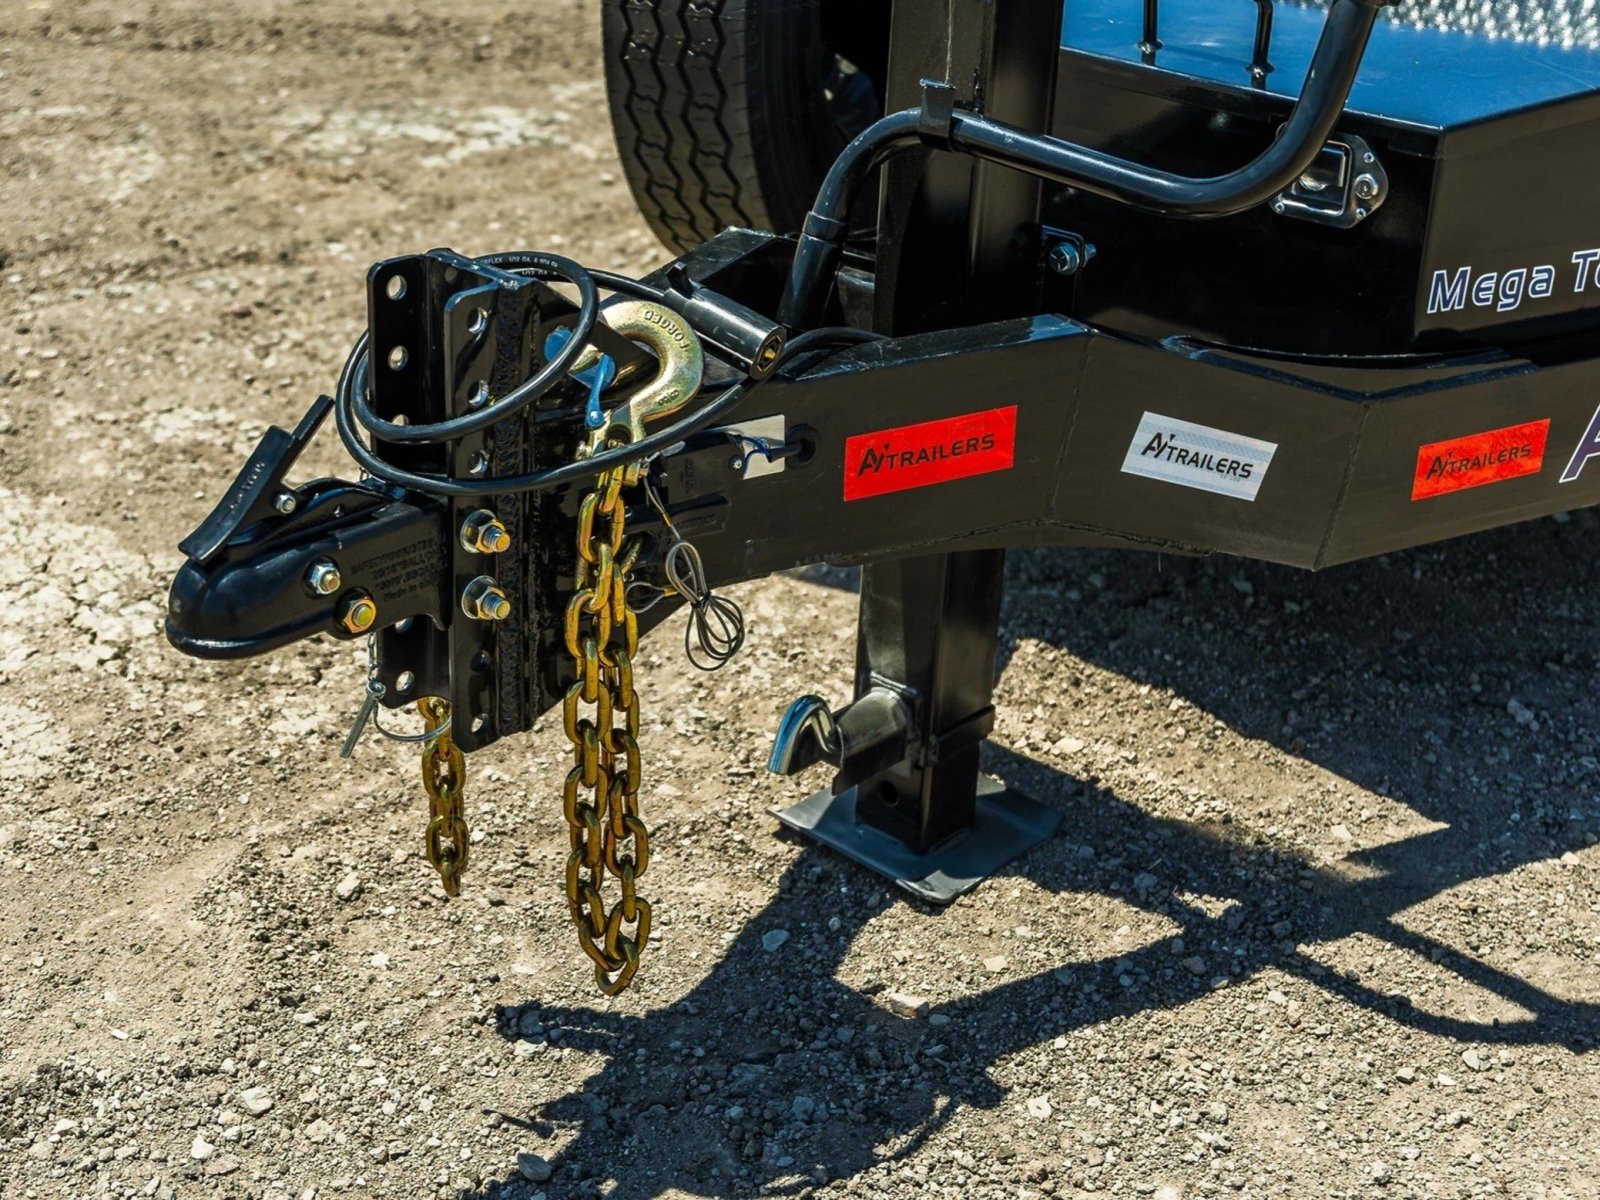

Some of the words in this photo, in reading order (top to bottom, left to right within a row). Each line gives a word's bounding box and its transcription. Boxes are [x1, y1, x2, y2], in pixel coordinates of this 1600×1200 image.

[1427, 265, 1556, 314] Mega
[1572, 248, 1600, 293] T
[644, 309, 690, 351] FORGED
